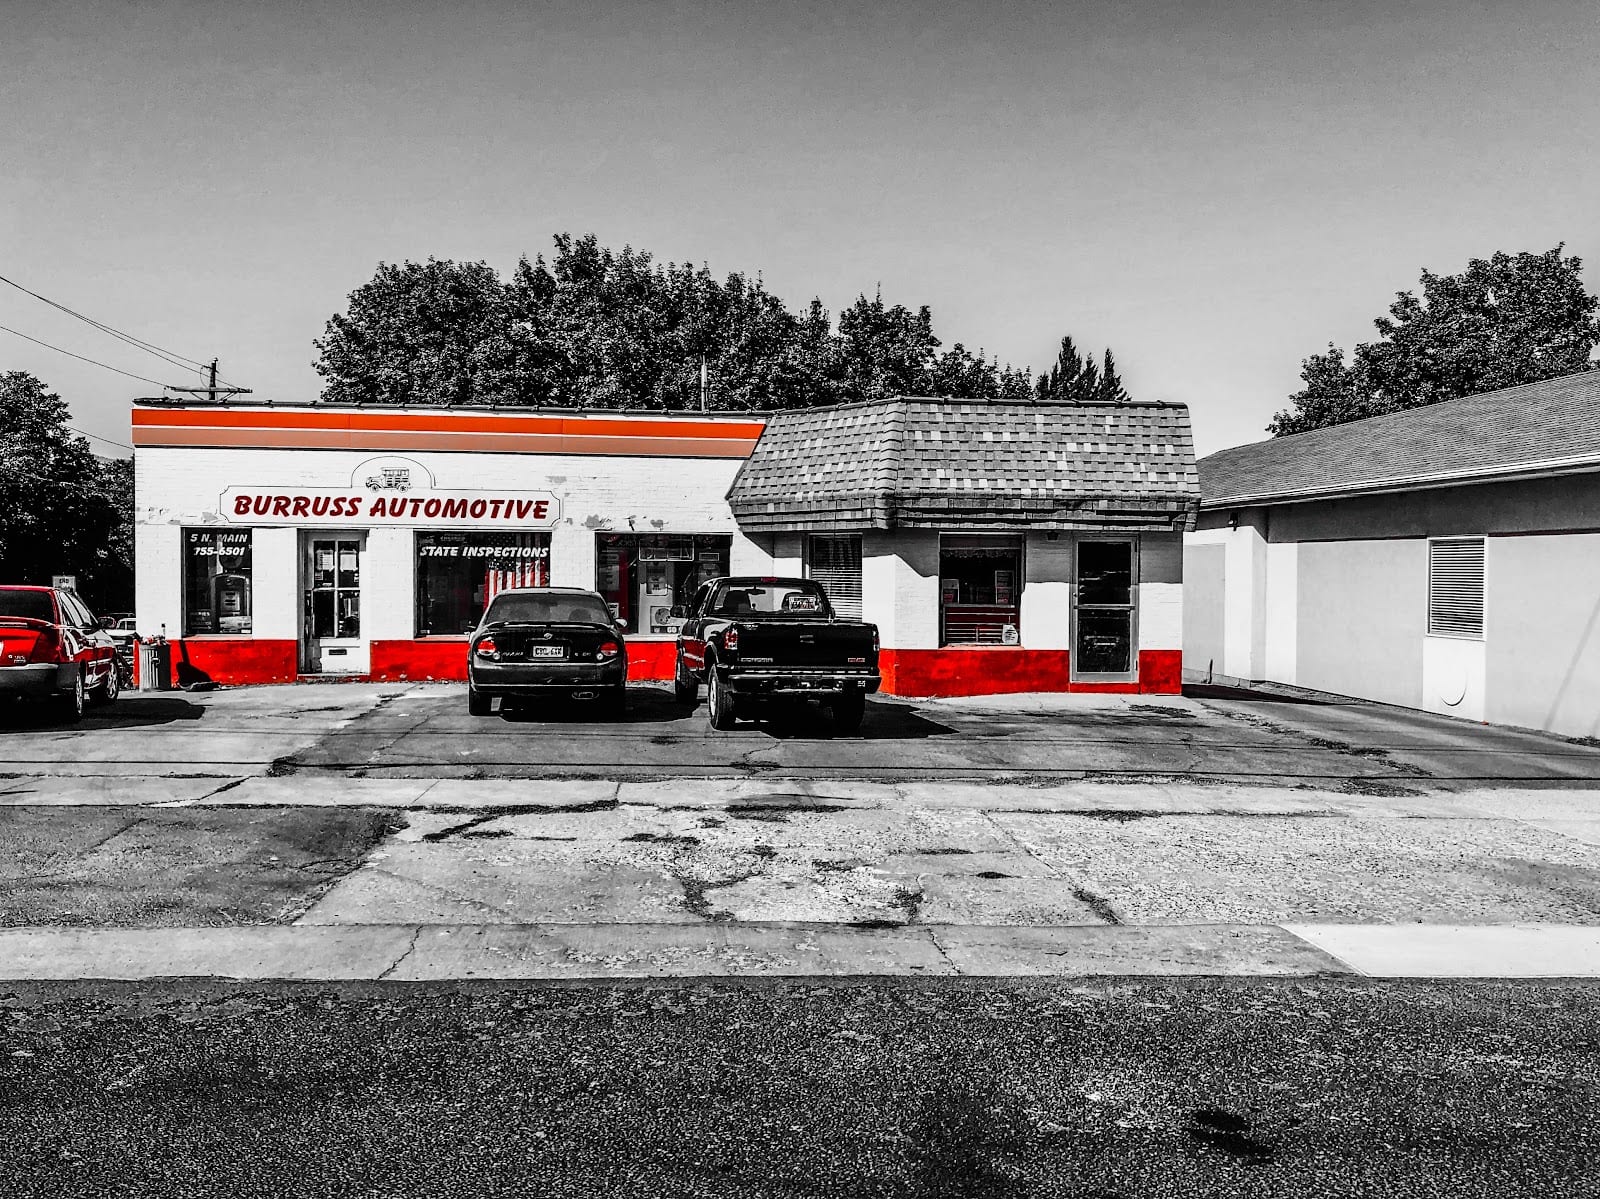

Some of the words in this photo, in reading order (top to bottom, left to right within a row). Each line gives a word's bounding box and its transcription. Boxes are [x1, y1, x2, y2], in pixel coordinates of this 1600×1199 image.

[233, 495, 362, 517] BURRUSS
[369, 497, 549, 519] AUTOMOTIVE
[190, 533, 199, 542] 5
[200, 533, 212, 542] N.
[217, 533, 248, 543] MAIN
[193, 546, 245, 556] 755-6501
[419, 546, 459, 557] STATE
[461, 546, 550, 558] INSPECTIONS
